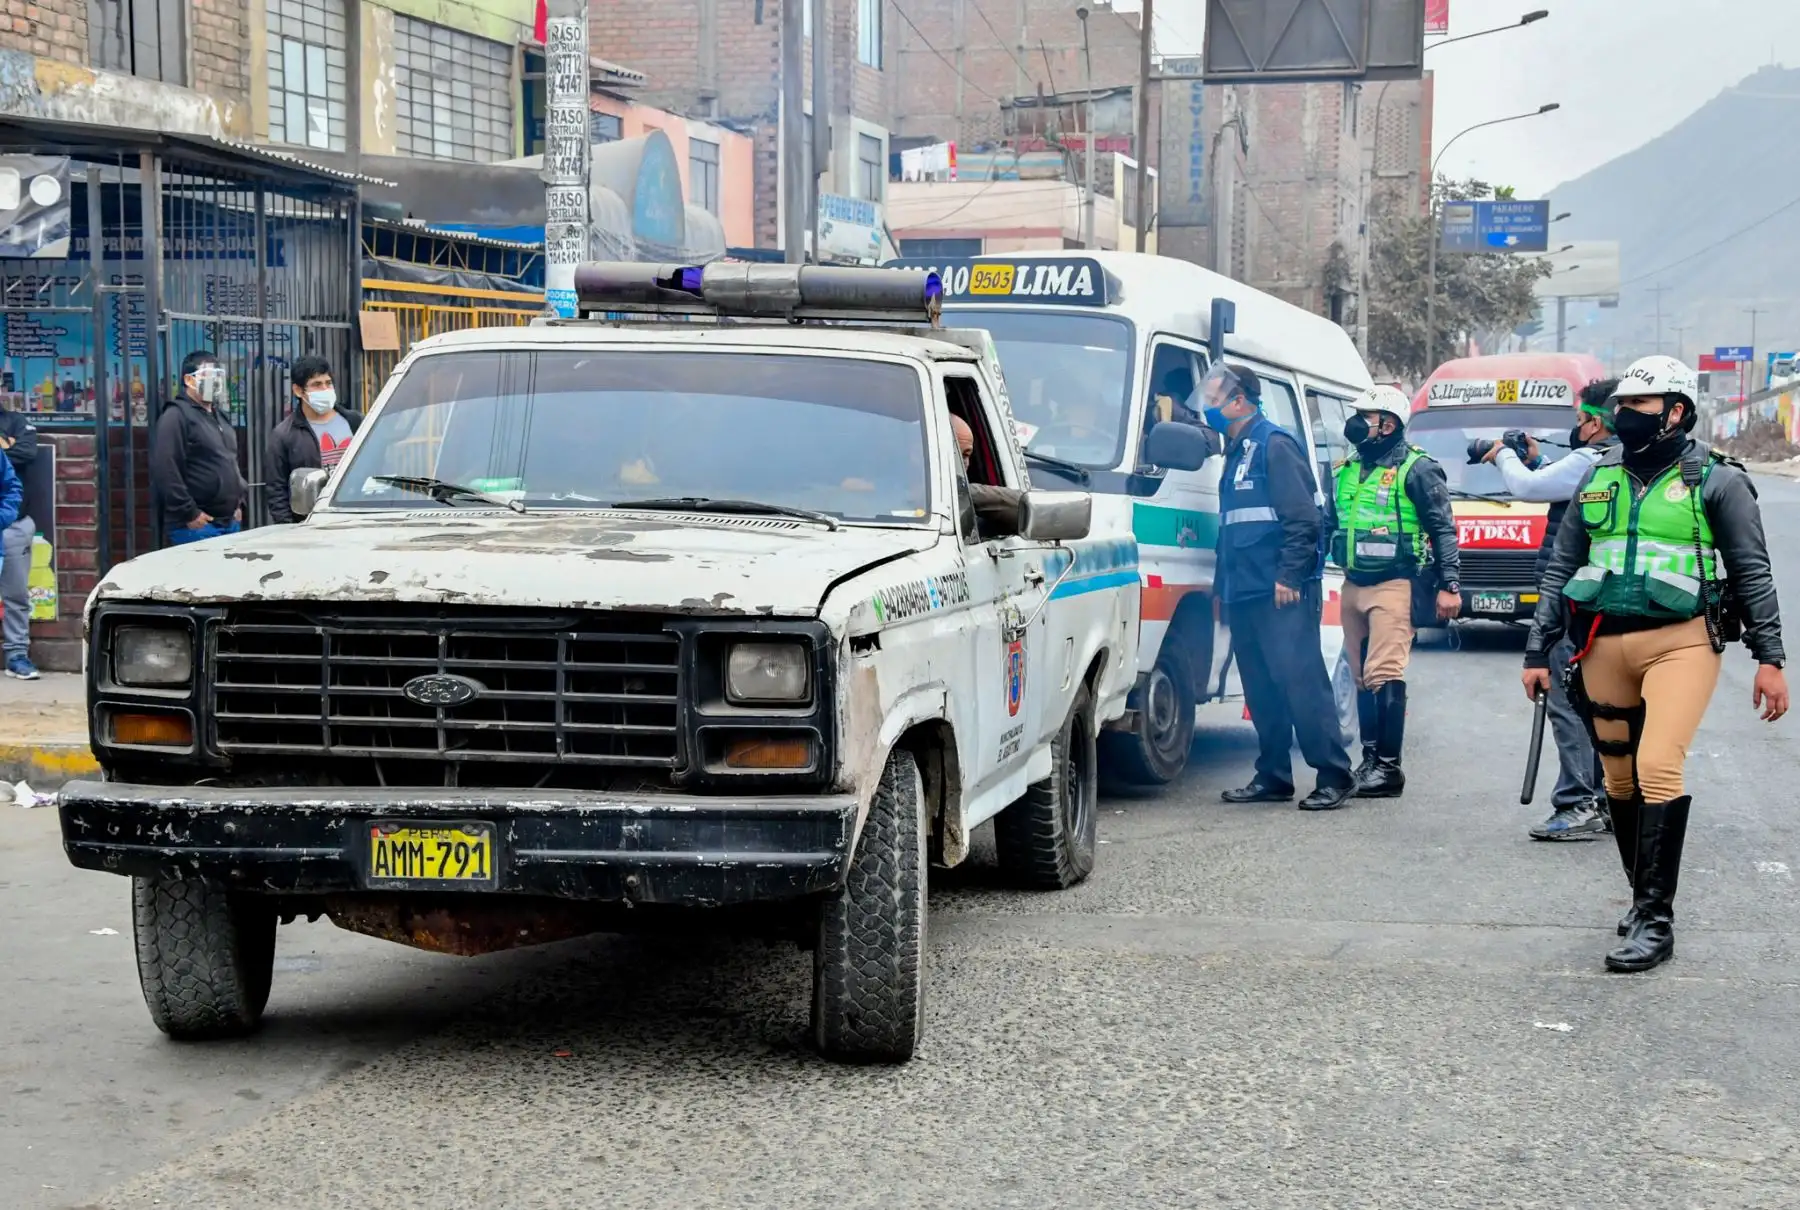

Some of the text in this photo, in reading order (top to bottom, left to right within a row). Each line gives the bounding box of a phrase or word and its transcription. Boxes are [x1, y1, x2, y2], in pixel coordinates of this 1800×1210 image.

[1011, 265, 1094, 295] LIMA
[1520, 379, 1567, 398] Lince
[1458, 524, 1531, 545] ETDESA
[408, 827, 453, 839] PERU
[374, 840, 488, 878] AMM-791
